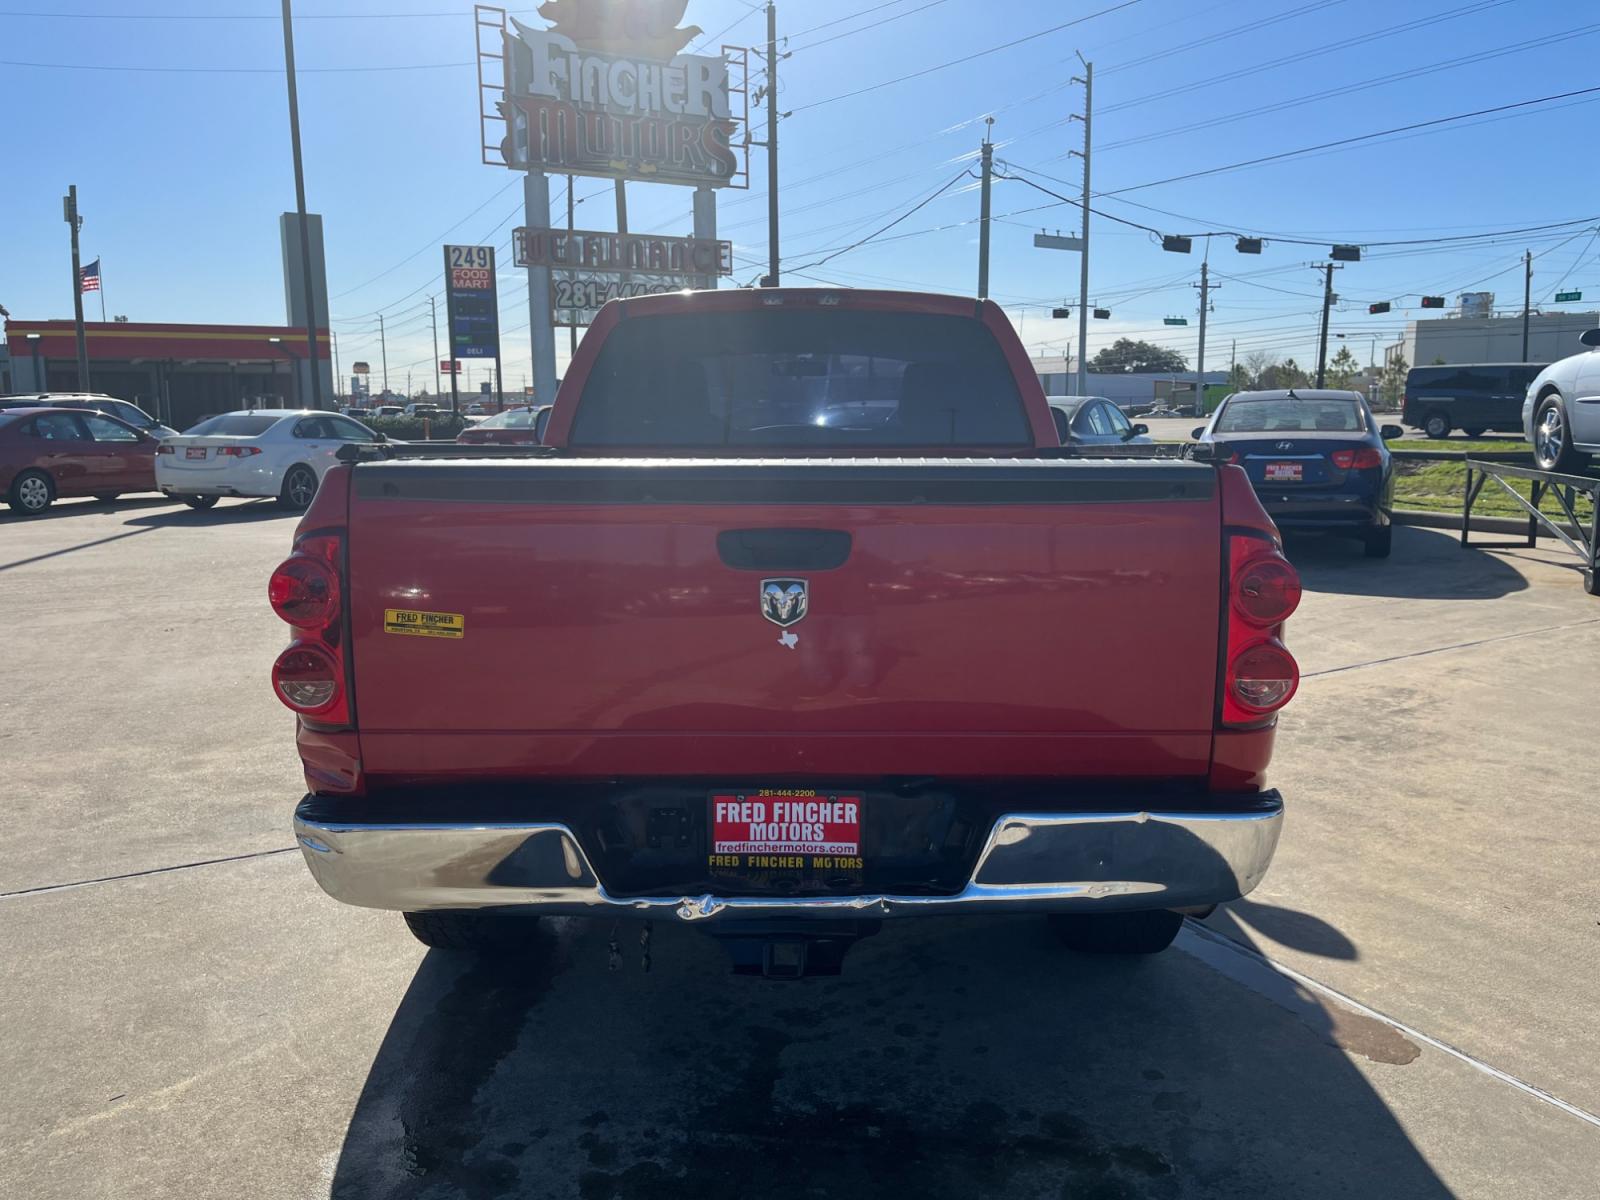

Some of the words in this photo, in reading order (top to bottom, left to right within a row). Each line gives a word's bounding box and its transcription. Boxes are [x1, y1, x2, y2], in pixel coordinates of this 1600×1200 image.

[498, 98, 739, 178] MOTORS
[452, 247, 487, 268] 249
[453, 269, 488, 279] FOOD
[453, 279, 489, 289] MART
[397, 613, 418, 622] FRED
[421, 614, 454, 624] FINCHER
[759, 789, 816, 797] 281-444-2200
[716, 802, 766, 823] FRED
[773, 802, 857, 824] FINCHER
[749, 823, 825, 841] MOTORS
[717, 843, 855, 854] fredfinchermotors.com
[708, 855, 740, 867] FRED
[748, 856, 804, 868] FINCHER
